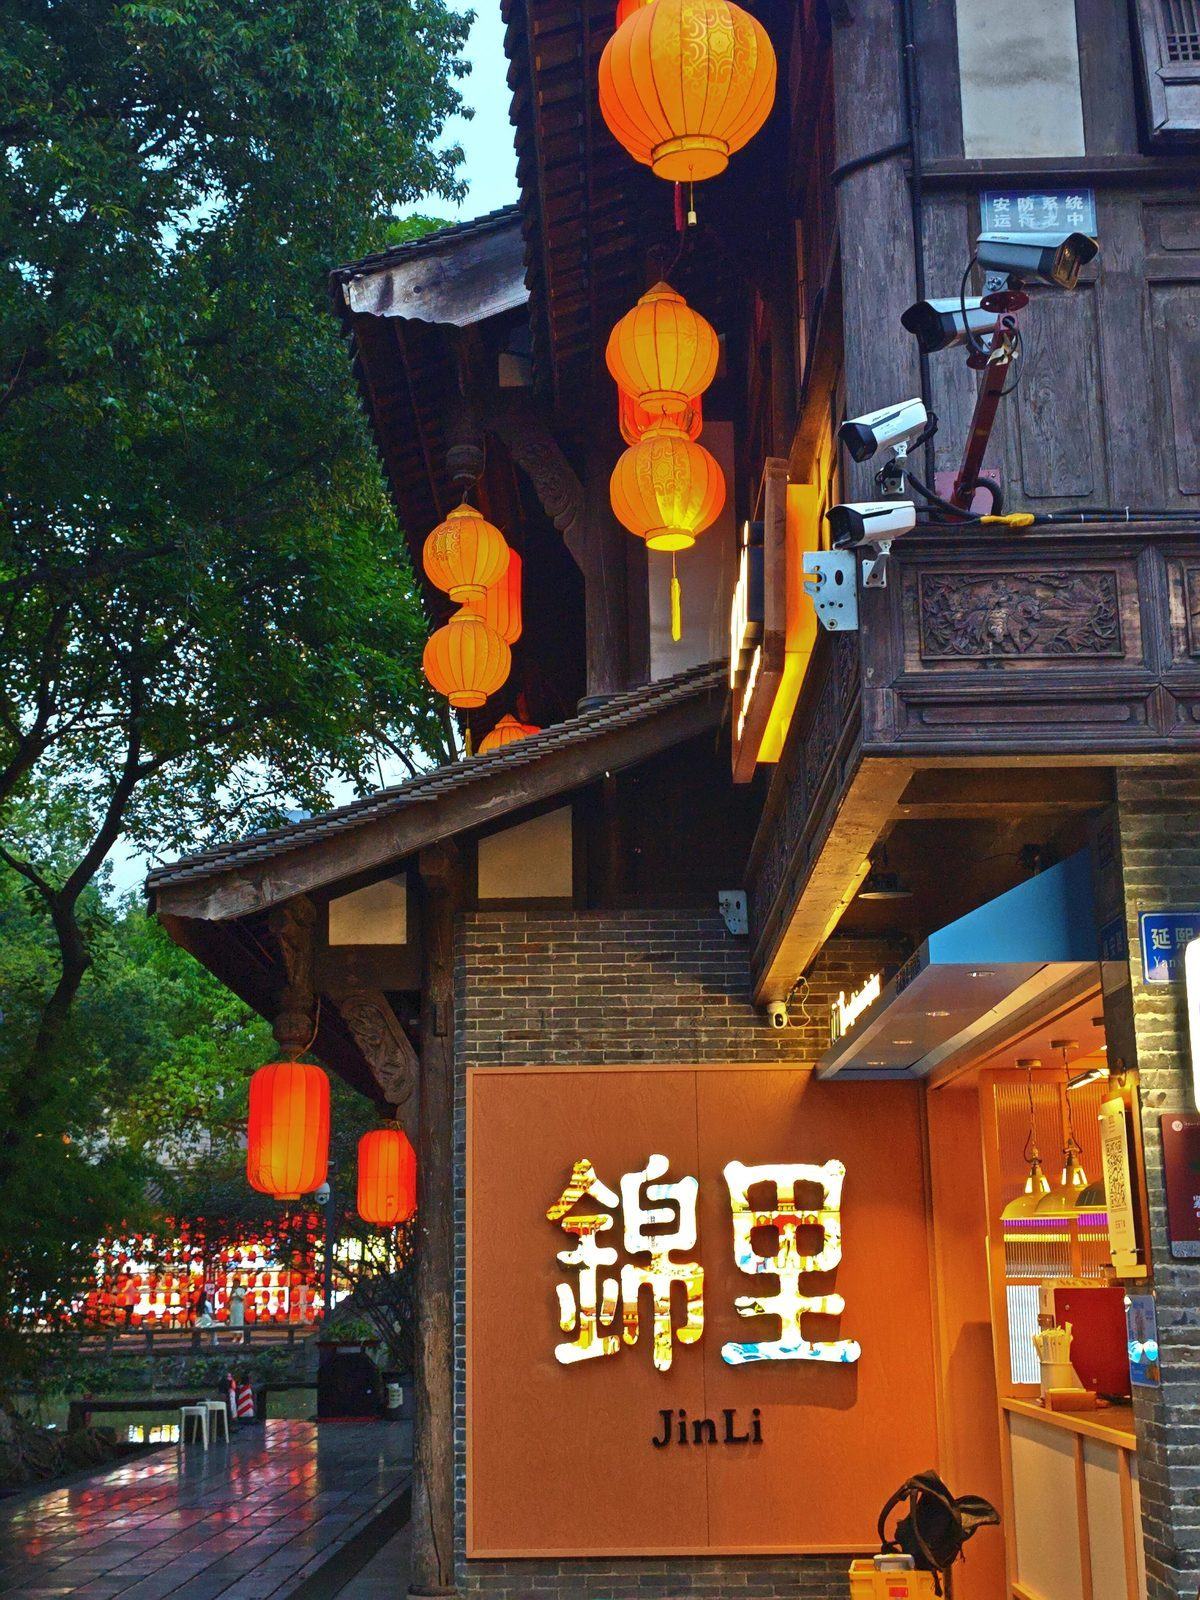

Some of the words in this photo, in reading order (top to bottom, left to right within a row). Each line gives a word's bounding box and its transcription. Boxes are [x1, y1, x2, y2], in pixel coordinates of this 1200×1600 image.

[993, 195, 1084, 211] 安防系统
[651, 1408, 764, 1448] JinLi
